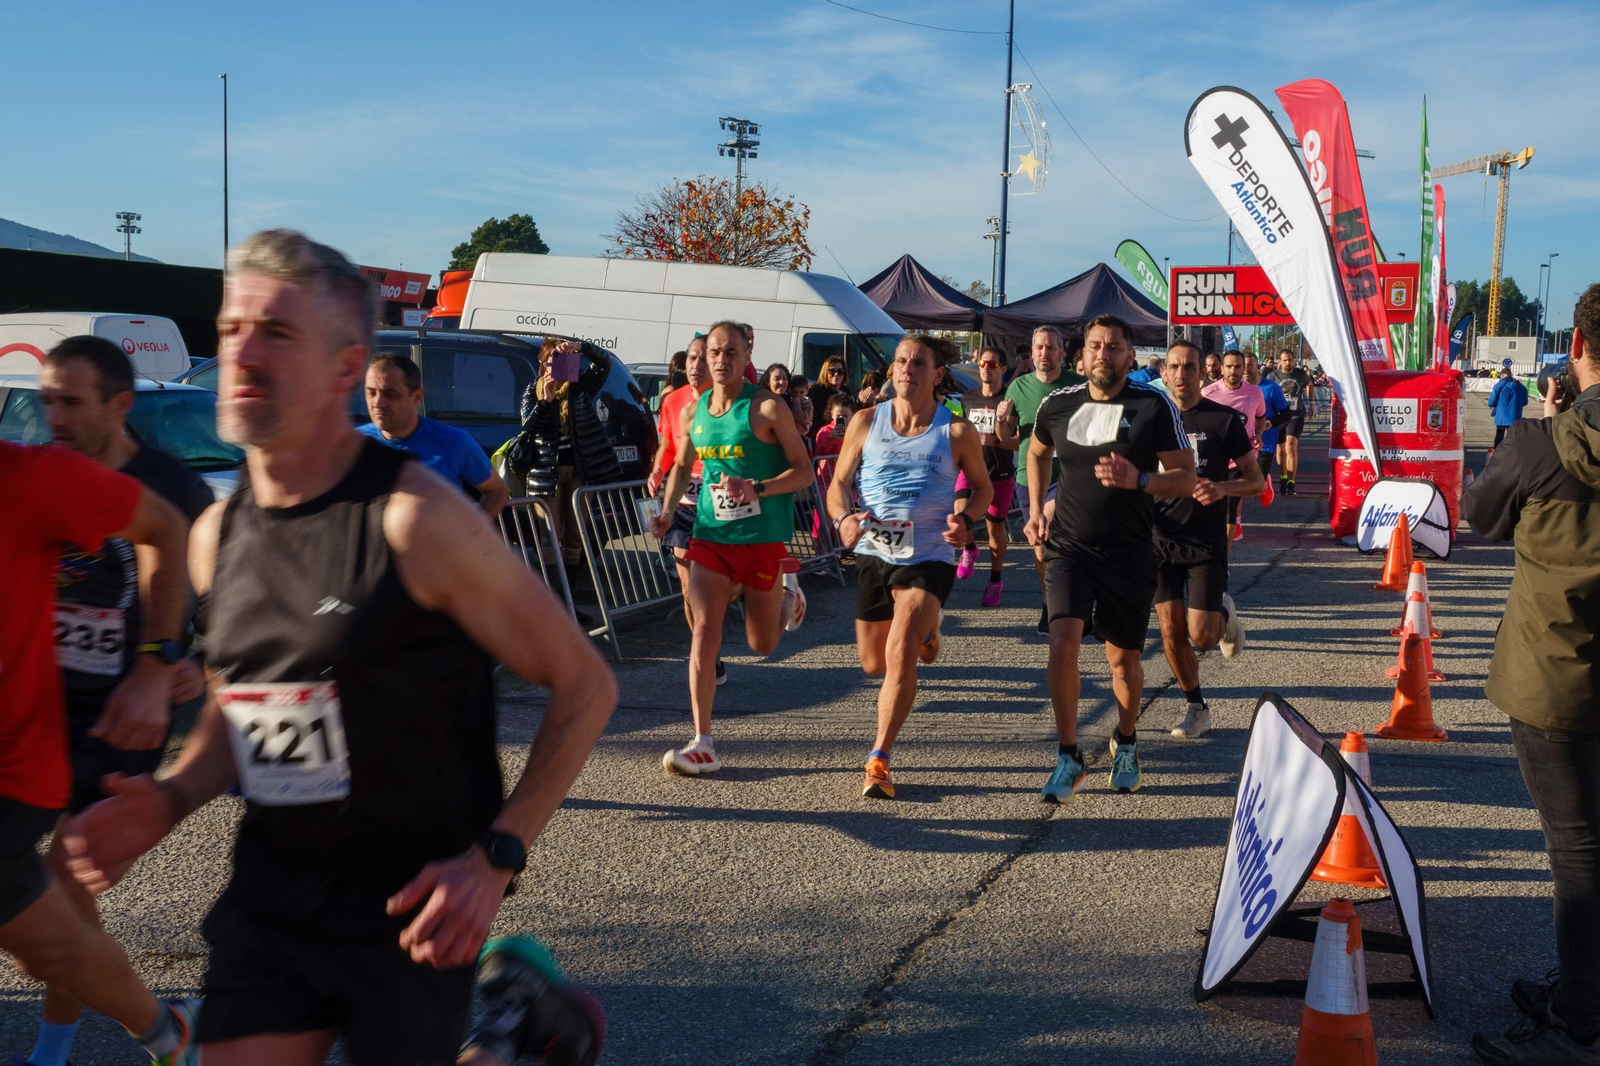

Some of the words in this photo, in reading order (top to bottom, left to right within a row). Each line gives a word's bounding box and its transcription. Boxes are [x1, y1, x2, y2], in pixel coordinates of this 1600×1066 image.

[1228, 150, 1294, 238] DEPORTE
[1231, 181, 1277, 244] Atlántico
[1177, 273, 1235, 295] RUN
[516, 314, 557, 327] acción
[136, 342, 170, 352] VEOLIA
[973, 415, 993, 426] 241
[1376, 416, 1405, 425] VIGO
[1380, 445, 1408, 456] VIGO,
[1390, 454, 1402, 462] de
[1405, 456, 1428, 465] xogo
[870, 527, 905, 547] 237
[52, 619, 124, 656] 235
[246, 715, 334, 764] 221
[1234, 769, 1278, 940] Atlántico
